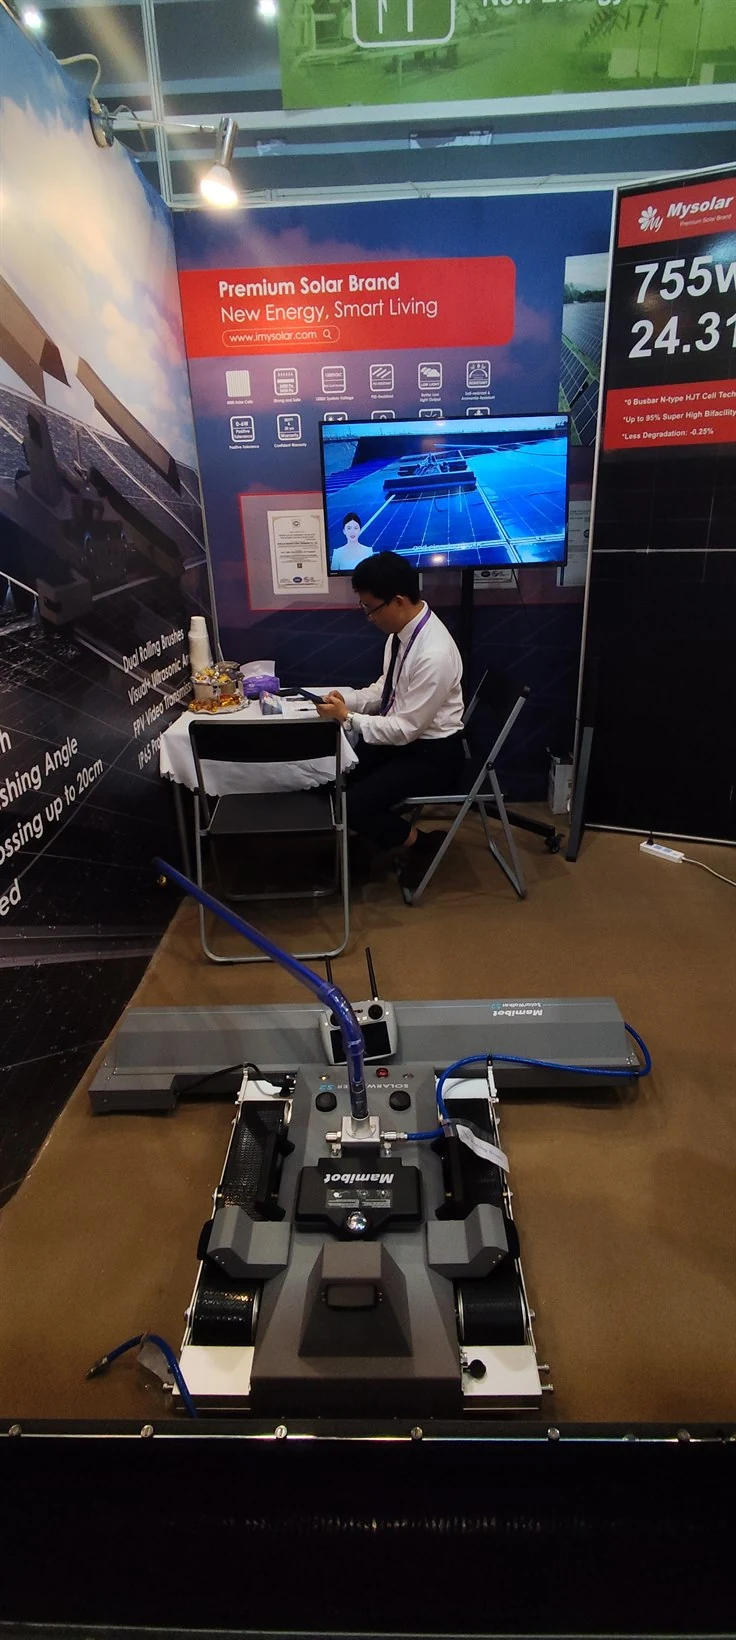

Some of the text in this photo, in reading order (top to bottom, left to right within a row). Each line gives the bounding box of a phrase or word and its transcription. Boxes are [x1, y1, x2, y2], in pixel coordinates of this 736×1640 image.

[666, 196, 734, 219] Mysolar
[218, 272, 399, 298] Premium Solar Brand
[220, 298, 438, 324] New Energy, Smart Living
[229, 330, 317, 342] www.imysolar.com
[628, 311, 736, 358] 24.31
[633, 397, 659, 405] Busbar
[660, 395, 684, 404] N-type
[686, 392, 700, 400] HJT
[702, 392, 717, 400] Cell
[686, 411, 702, 420] High
[642, 430, 688, 440] Degradation:
[690, 428, 714, 436] -0.25%
[122, 628, 184, 674] Dual Rolling Brushes
[151, 658, 182, 688] Ultrasonic
[133, 712, 145, 739] FPV
[145, 701, 164, 726] Video
[138, 747, 152, 770] IP65
[0, 736, 78, 810] shing Angle
[45, 796, 63, 822] up
[65, 785, 76, 806] to
[76, 759, 103, 794] 20cm
[493, 1009, 543, 1017] Mamibot
[324, 1173, 394, 1184] Mamibot
